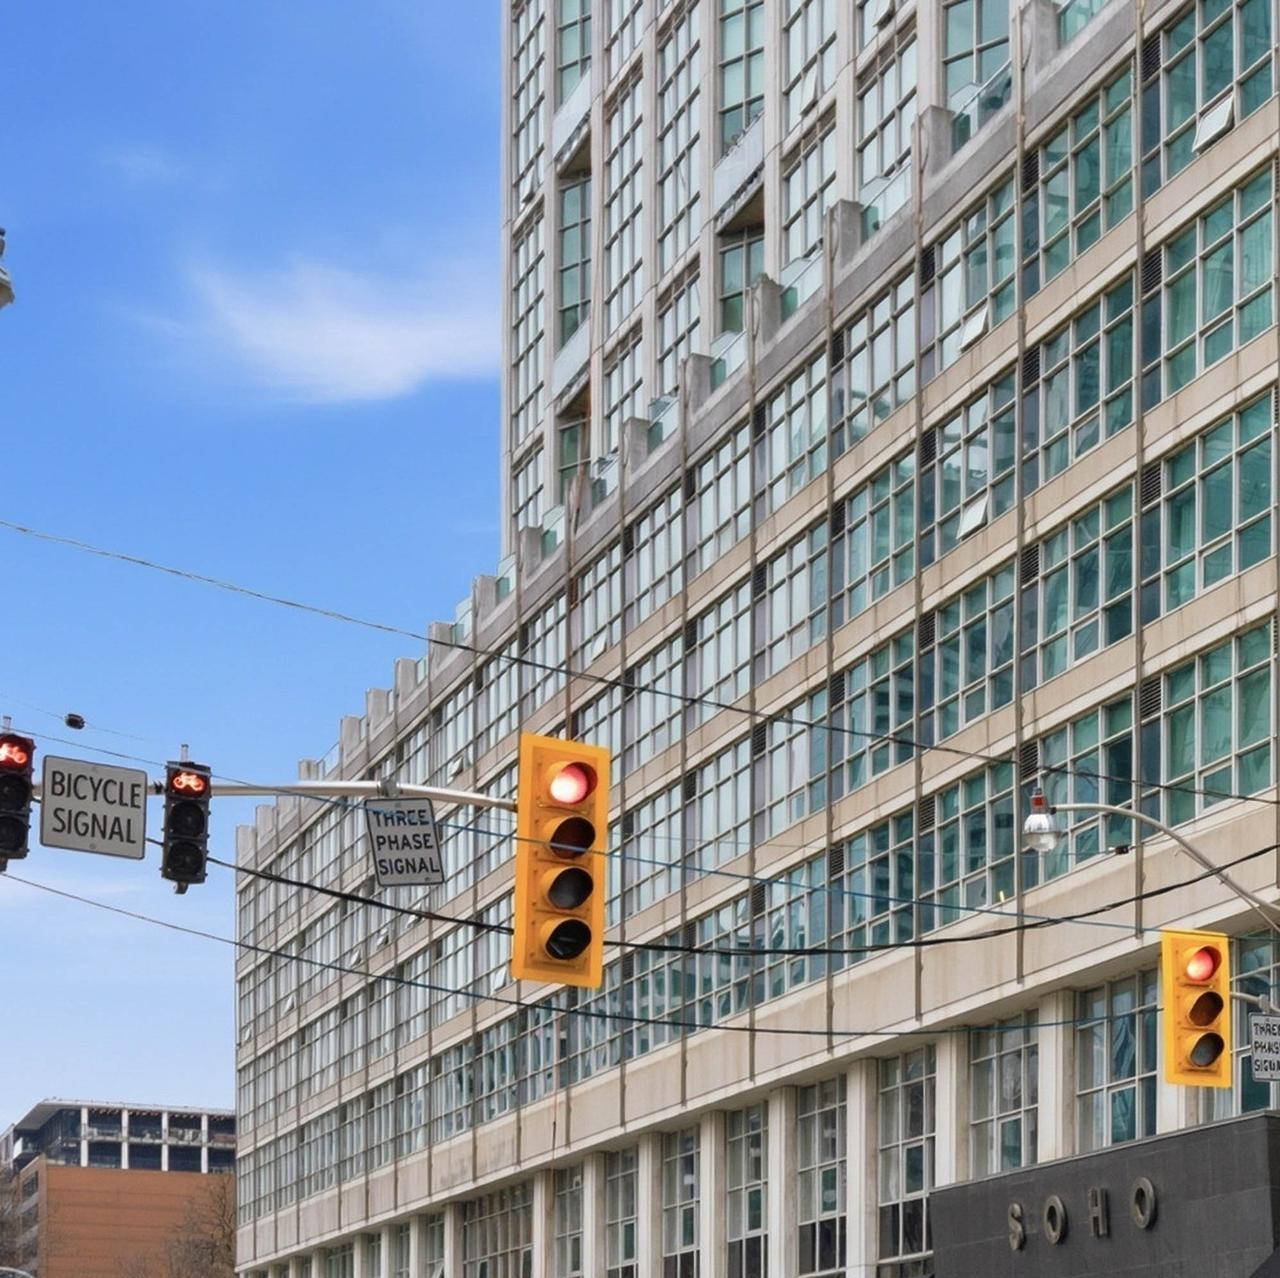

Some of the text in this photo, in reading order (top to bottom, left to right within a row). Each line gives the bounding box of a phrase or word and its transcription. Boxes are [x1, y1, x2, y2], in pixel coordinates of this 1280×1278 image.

[51, 770, 141, 809] BICYCLE
[52, 807, 137, 844] SIGNAL
[373, 809, 430, 827] THREE
[376, 833, 434, 851] PHASE
[378, 857, 440, 875] SIGNAL
[1007, 1177, 1156, 1251] SOHO
